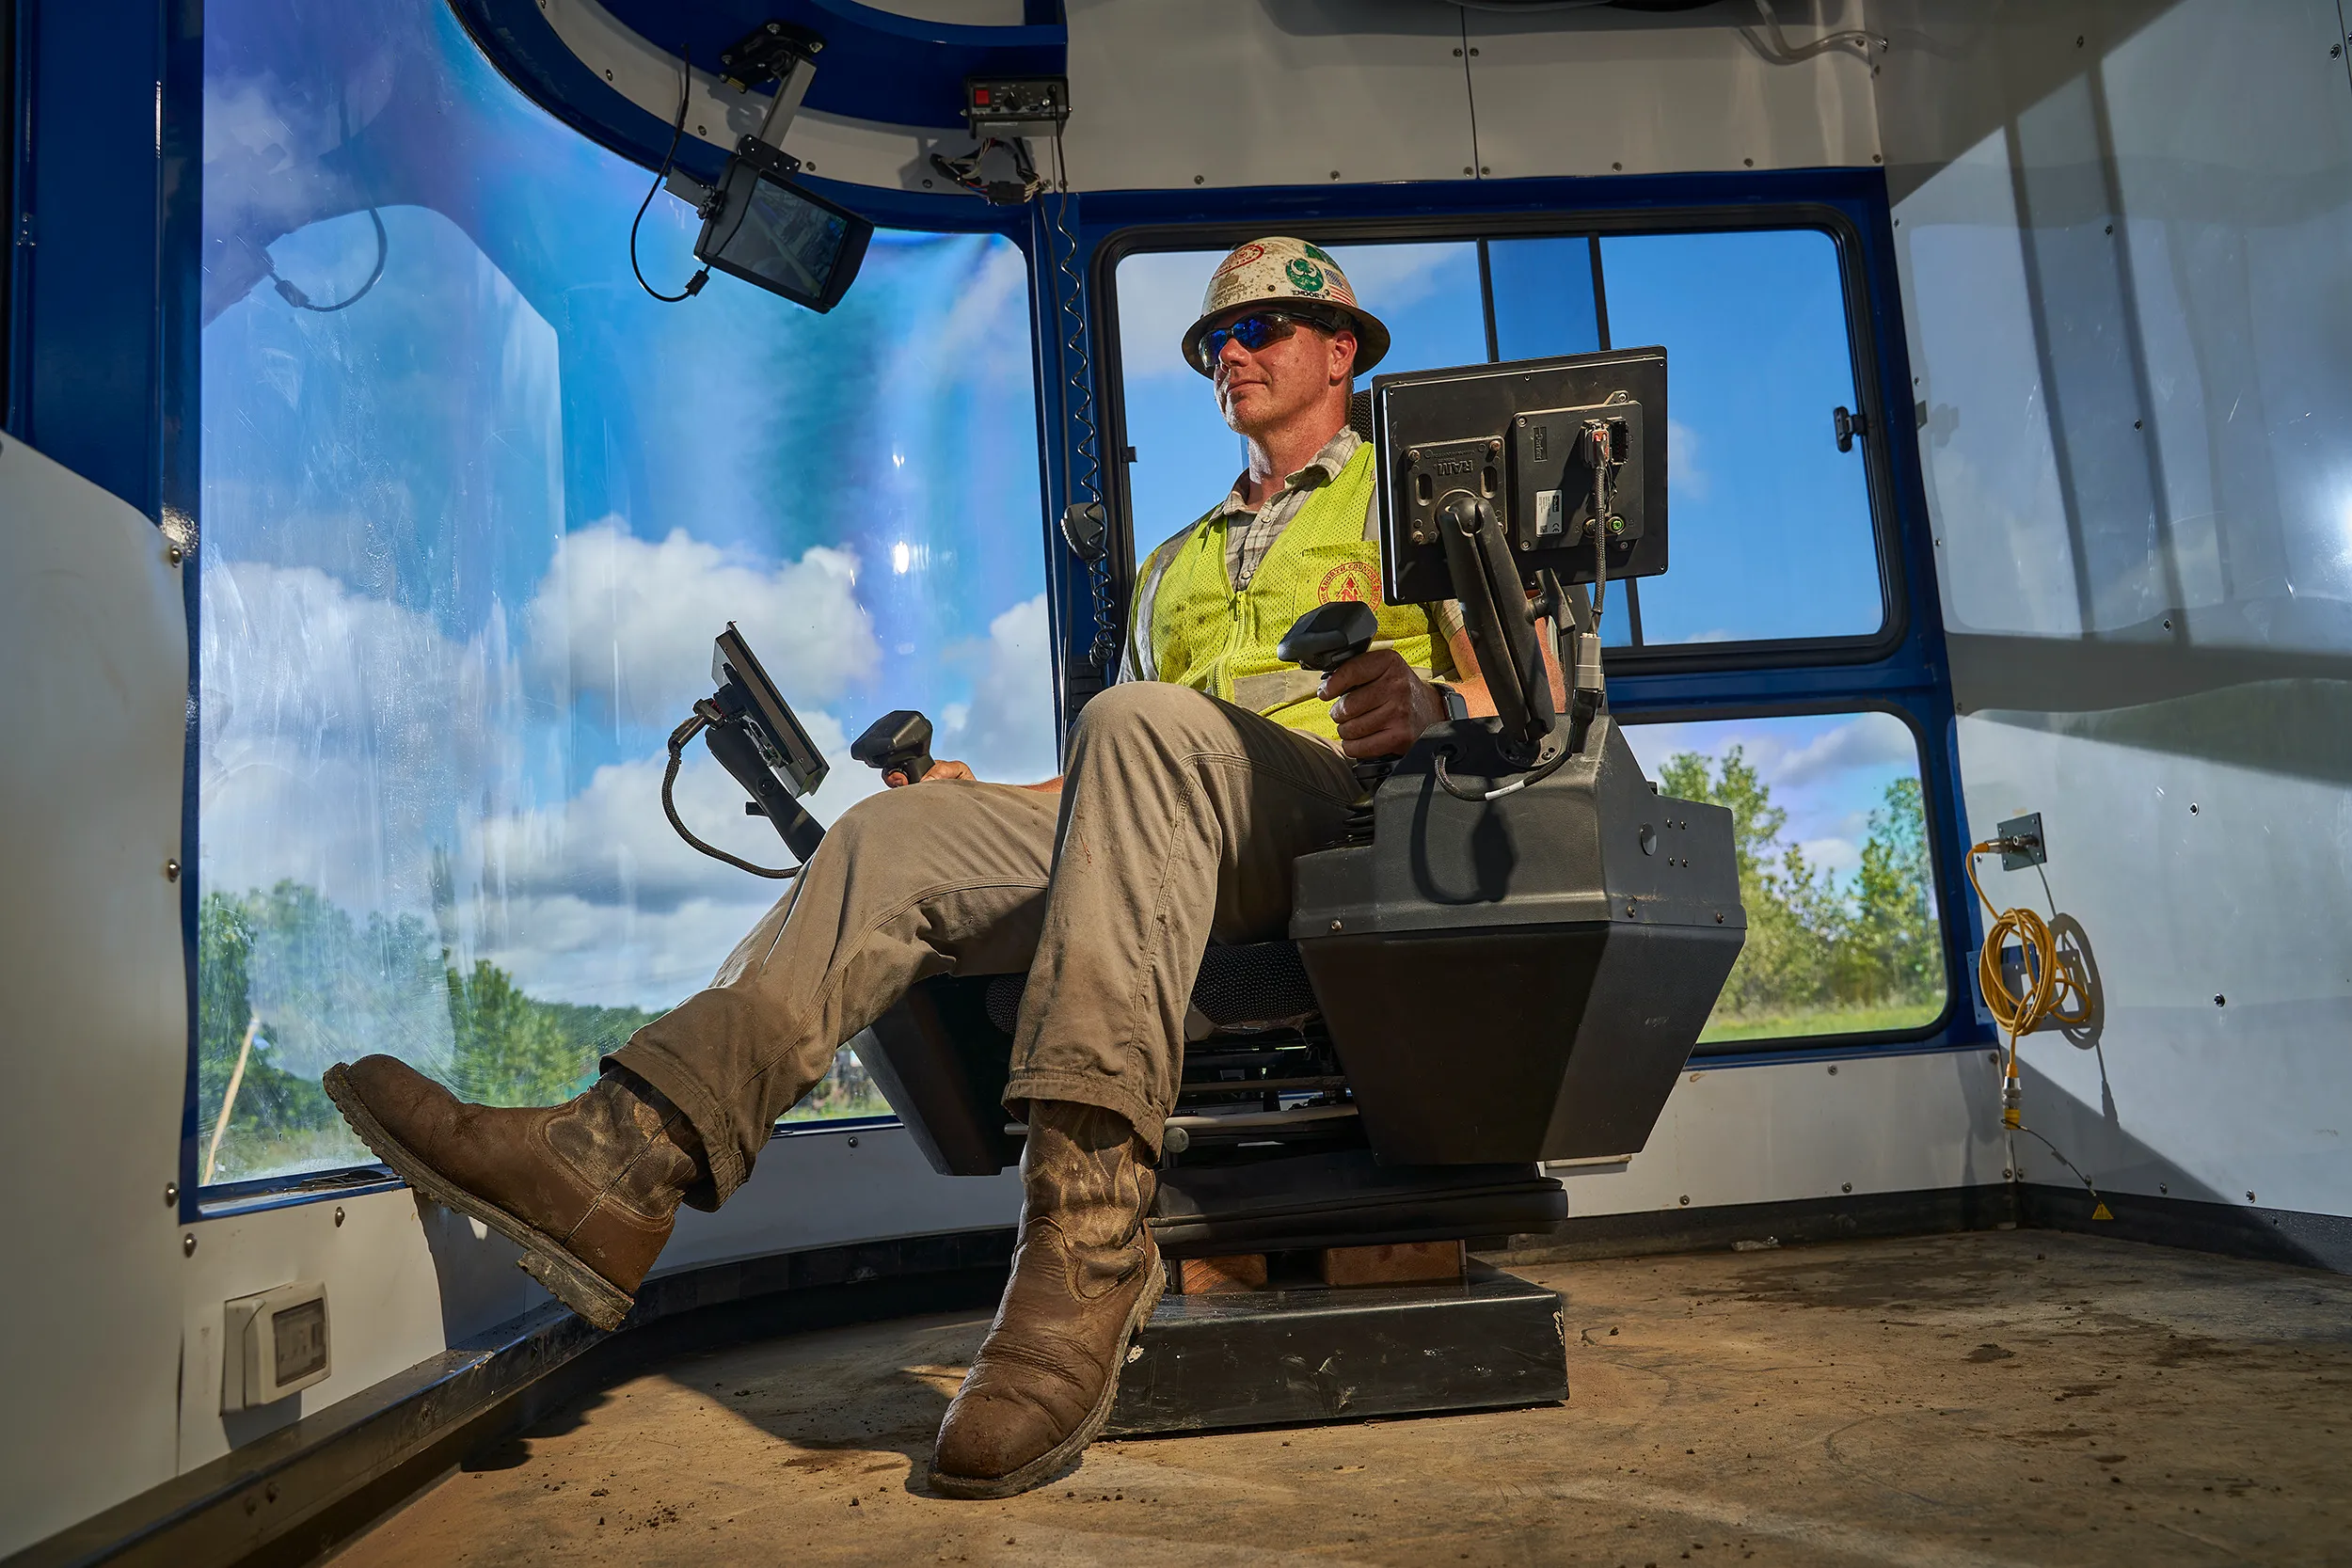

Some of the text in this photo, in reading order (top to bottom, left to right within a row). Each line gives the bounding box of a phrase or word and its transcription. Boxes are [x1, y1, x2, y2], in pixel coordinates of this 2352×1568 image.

[1438, 459, 1474, 477] RAM
[1323, 563, 1381, 587] NORTH COUNTRY
